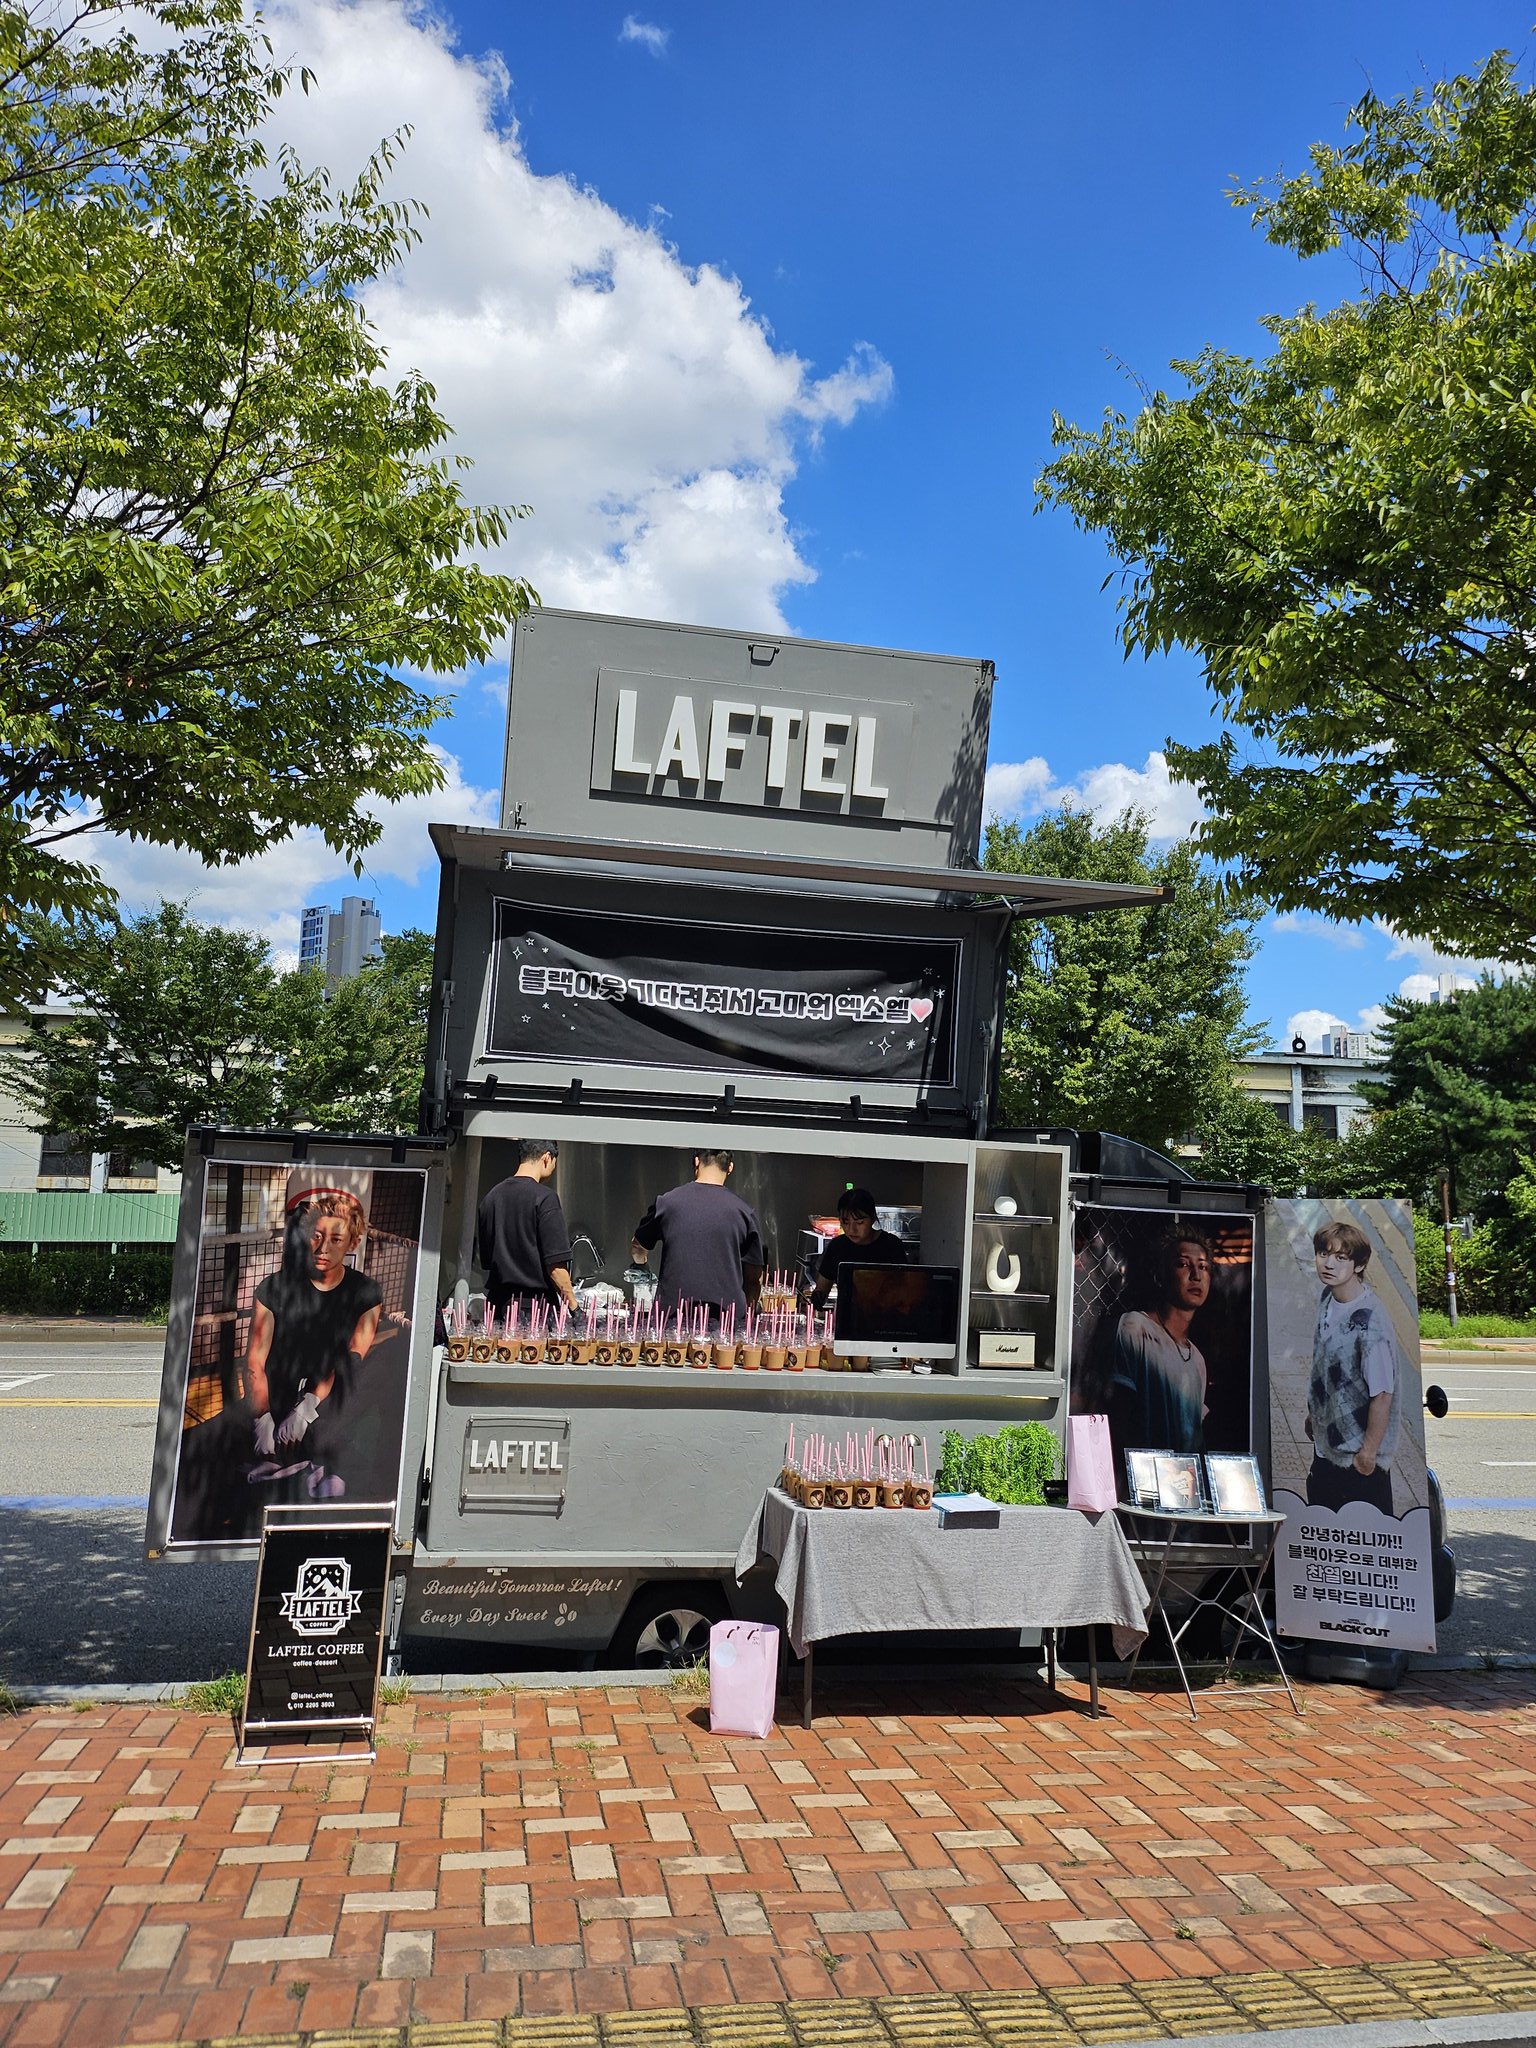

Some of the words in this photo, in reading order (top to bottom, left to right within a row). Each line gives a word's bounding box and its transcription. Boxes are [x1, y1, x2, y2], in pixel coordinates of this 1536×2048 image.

[614, 689, 889, 799] LAFTEL
[519, 965, 627, 1001] 블랙아웃
[628, 979, 755, 1015] 기다려줘서
[755, 989, 833, 1020] 고마워
[835, 994, 911, 1023] 엑소엘
[470, 1440, 563, 1469] LAFTEL
[1300, 1525, 1403, 1550] 안녕하십니까!!
[1288, 1543, 1375, 1567] 블랙아웃으로
[1378, 1556, 1418, 1572] 데뷔한
[422, 1579, 498, 1599] Beautiful
[498, 1579, 565, 1595] Tomorrow
[1306, 1563, 1399, 1590] 찬열입니다!!
[296, 1601, 345, 1617] LAFTEL
[1292, 1584, 1308, 1600] 잘
[1312, 1587, 1416, 1613] 부탁드립니다!!
[420, 1608, 462, 1628] Every
[466, 1607, 501, 1627] Day
[504, 1607, 548, 1622] Sweet
[1320, 1621, 1362, 1635] BLACK
[1363, 1626, 1390, 1637] OUT
[267, 1645, 315, 1657] LAFTEL
[317, 1643, 365, 1655] COFFEE
